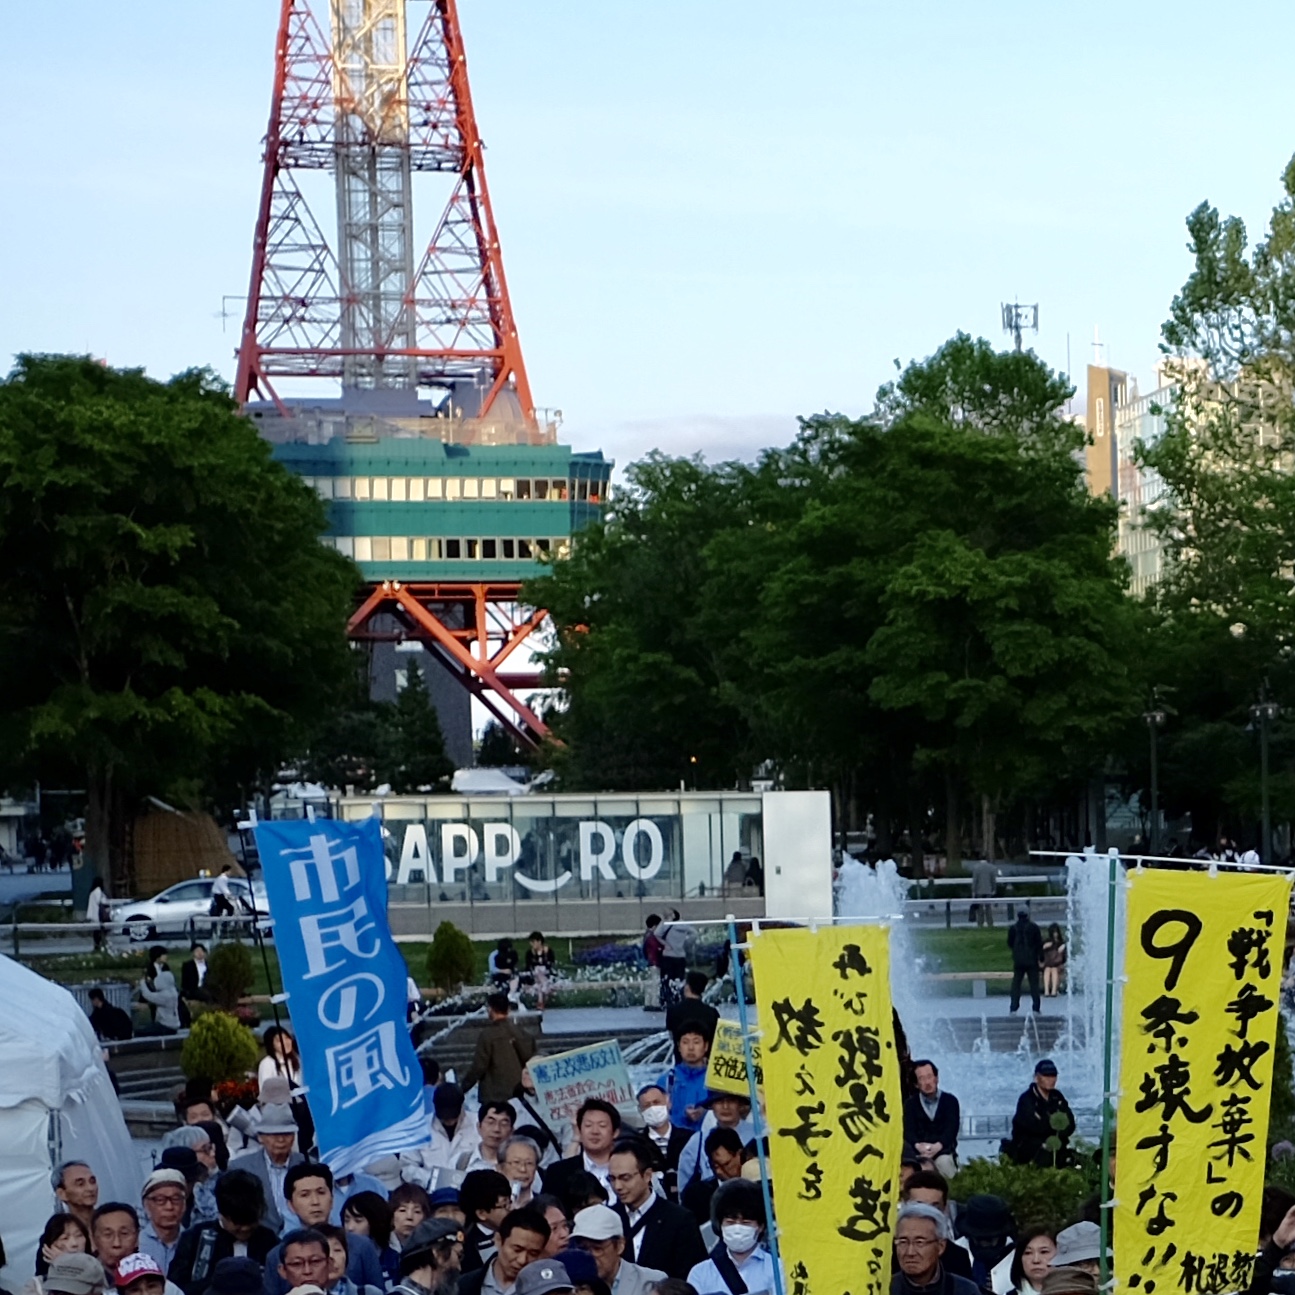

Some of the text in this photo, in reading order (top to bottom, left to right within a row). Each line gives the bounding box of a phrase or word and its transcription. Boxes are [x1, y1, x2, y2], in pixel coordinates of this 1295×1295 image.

[279, 834, 411, 1117] 市民の風
[381, 822, 521, 885] APP
[1207, 910, 1274, 1219] 「戦争放棄」の
